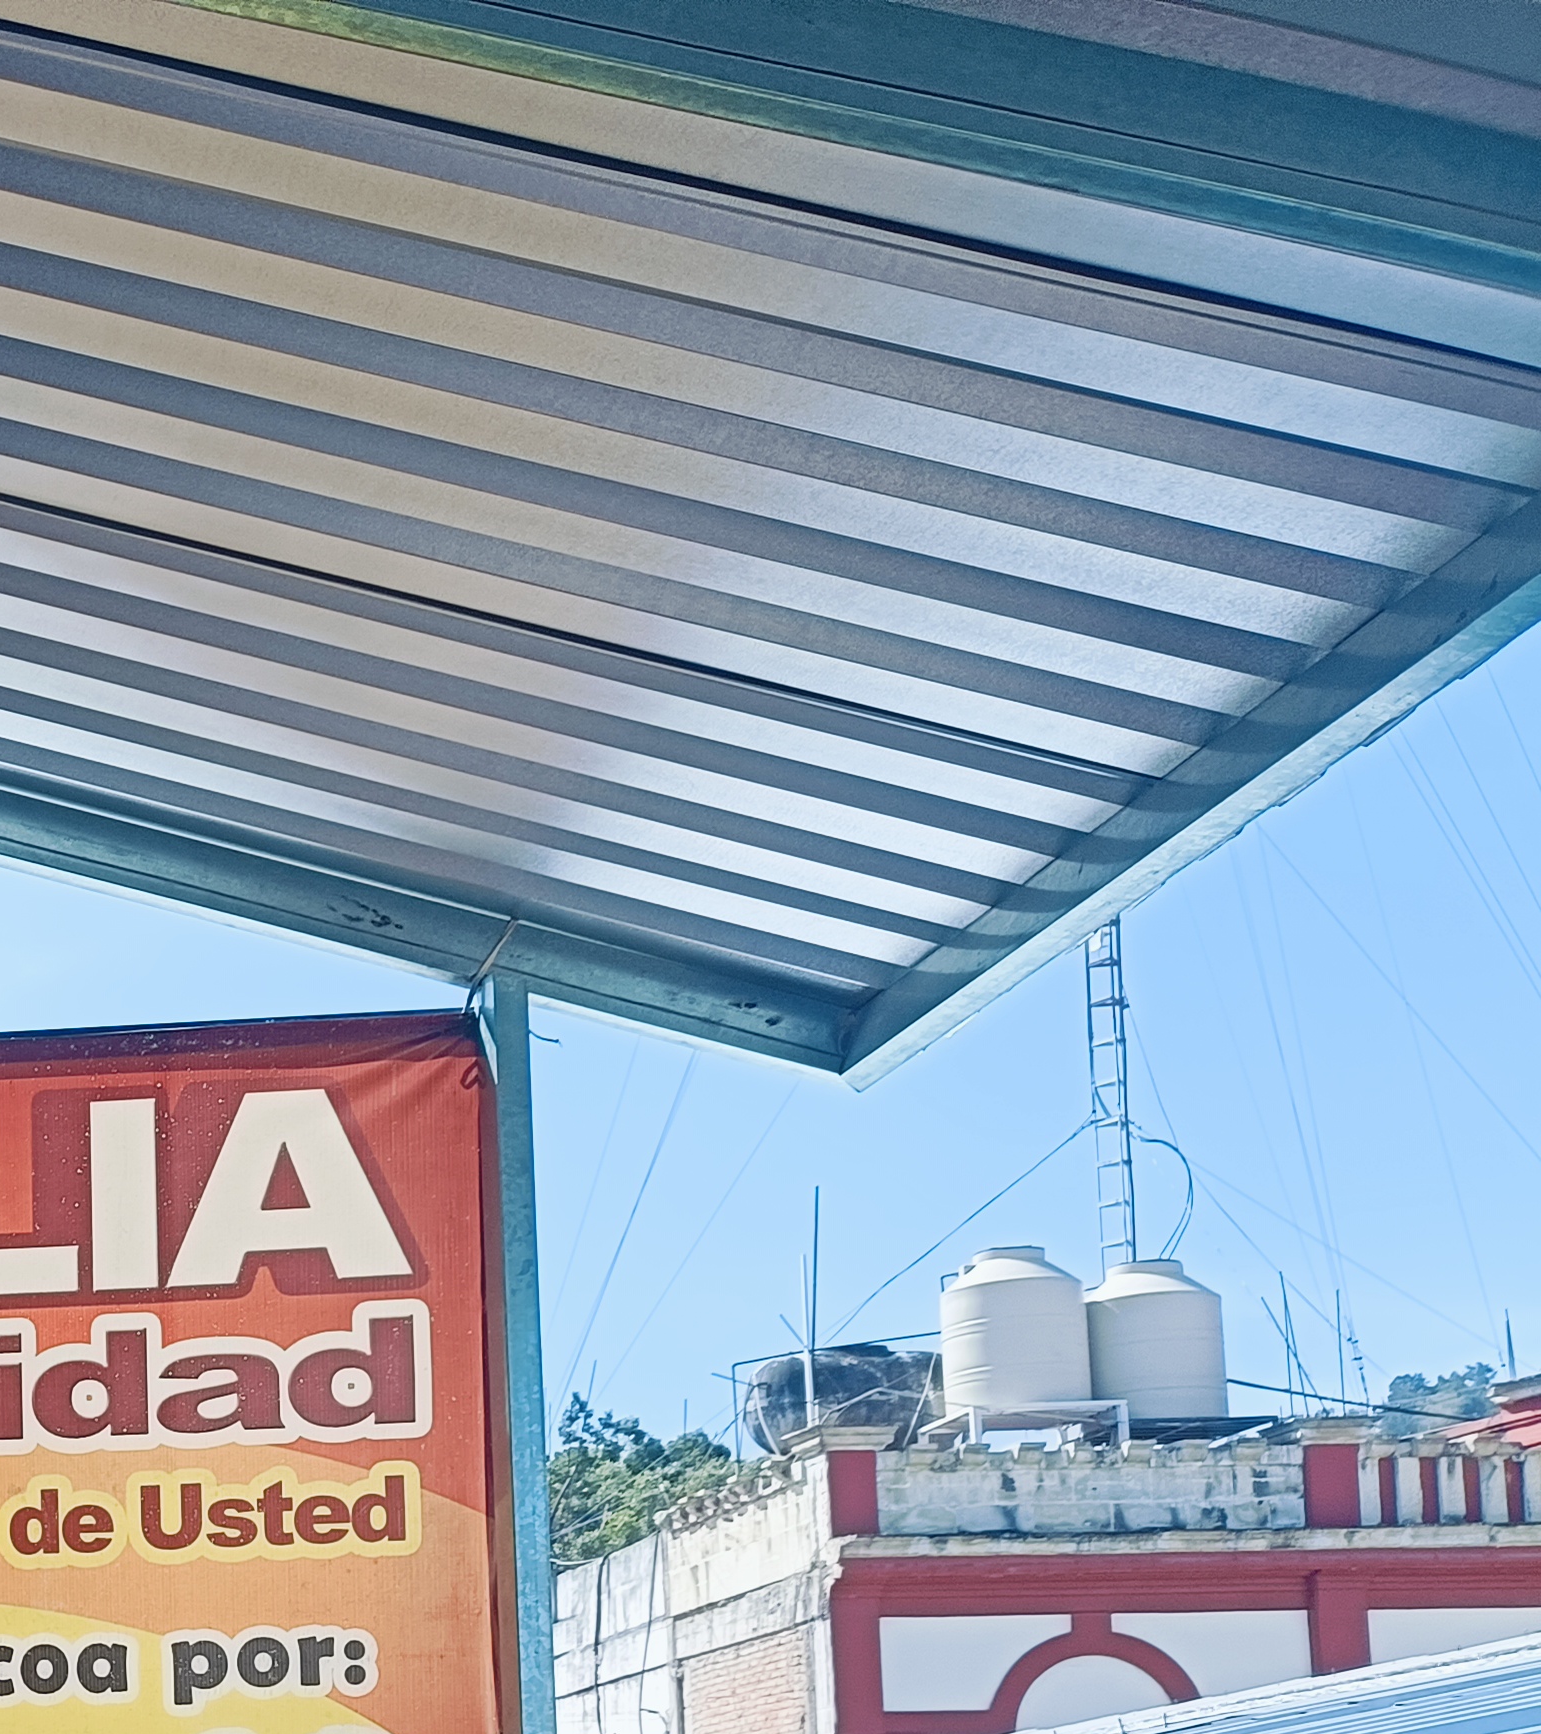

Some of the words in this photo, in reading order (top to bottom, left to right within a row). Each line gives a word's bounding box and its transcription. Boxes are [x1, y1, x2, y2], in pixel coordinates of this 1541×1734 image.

[9, 1489, 114, 1555] de
[139, 1475, 407, 1551] Usted
[172, 1634, 366, 1706] por:
